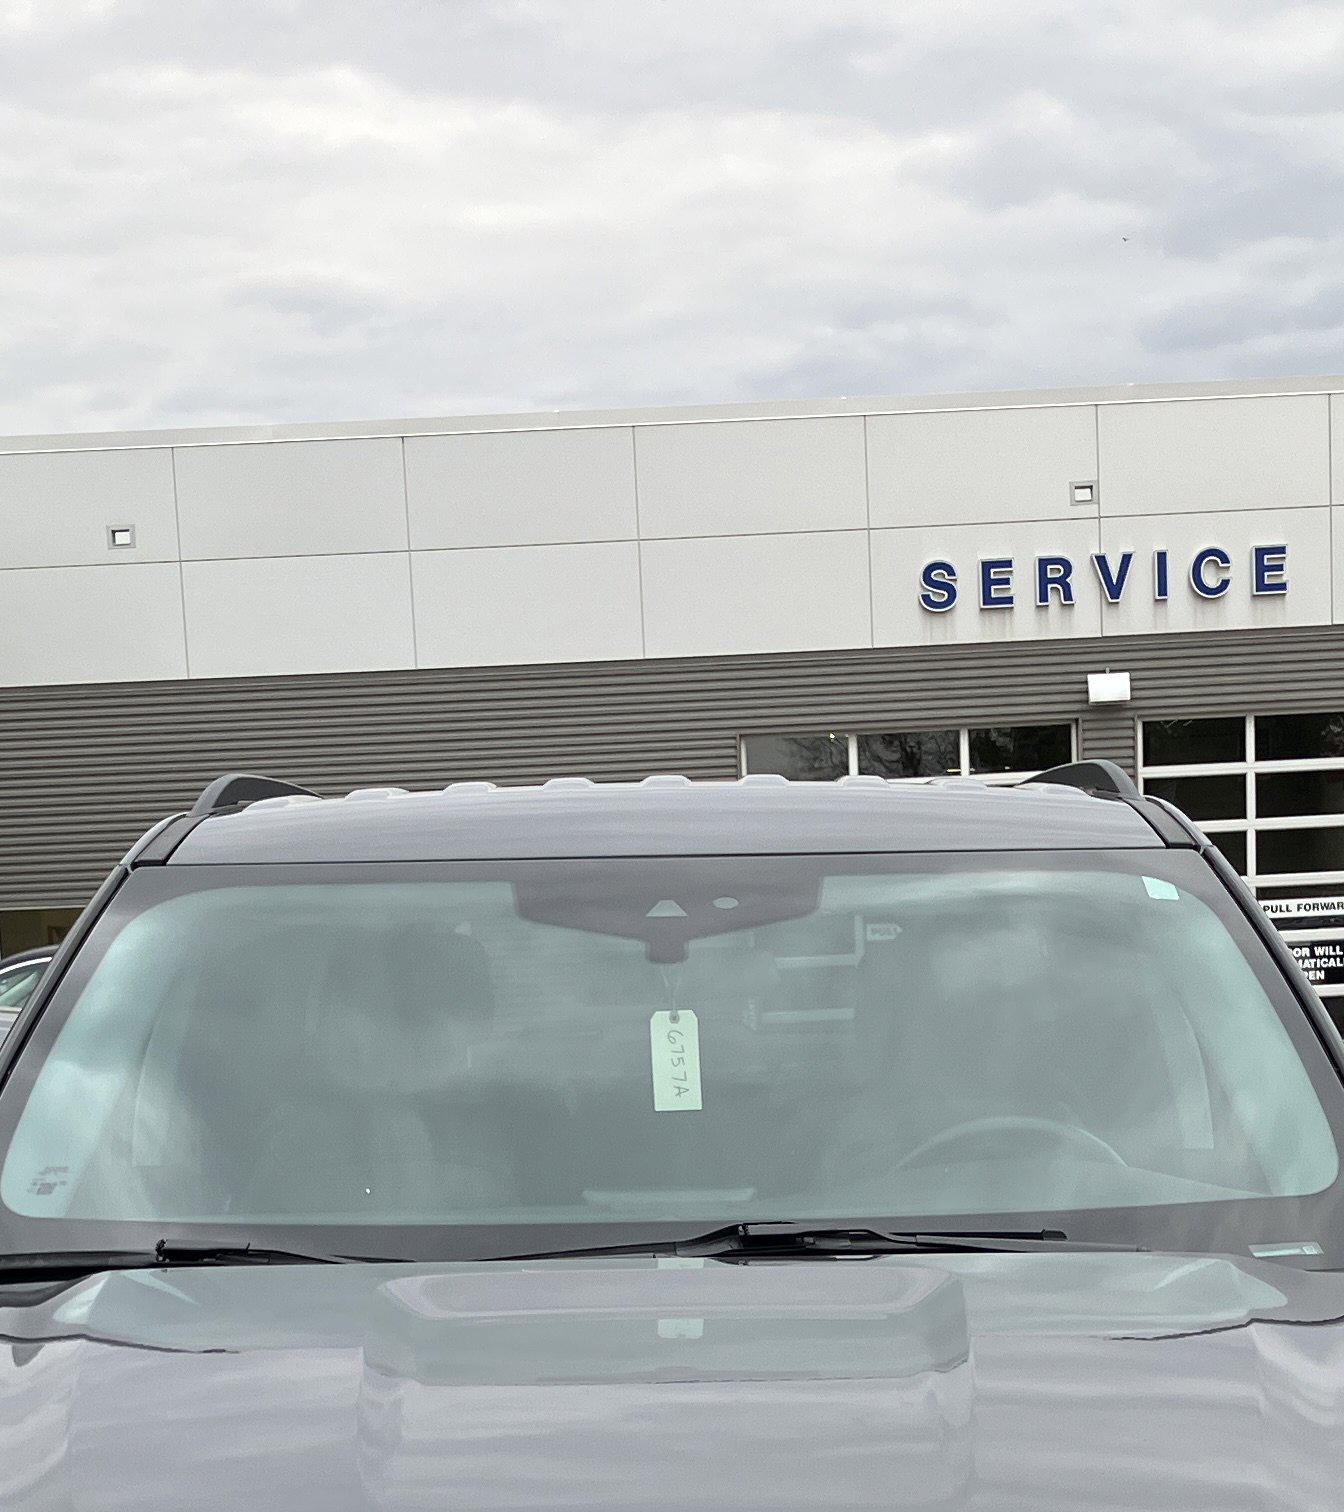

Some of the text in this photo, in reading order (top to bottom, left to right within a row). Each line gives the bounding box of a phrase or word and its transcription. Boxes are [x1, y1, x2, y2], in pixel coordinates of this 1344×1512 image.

[919, 543, 1288, 612] SERVICE
[1263, 904, 1292, 914] PULL
[1290, 945, 1343, 958] OR WILL
[667, 1030, 689, 1098] 6757A
